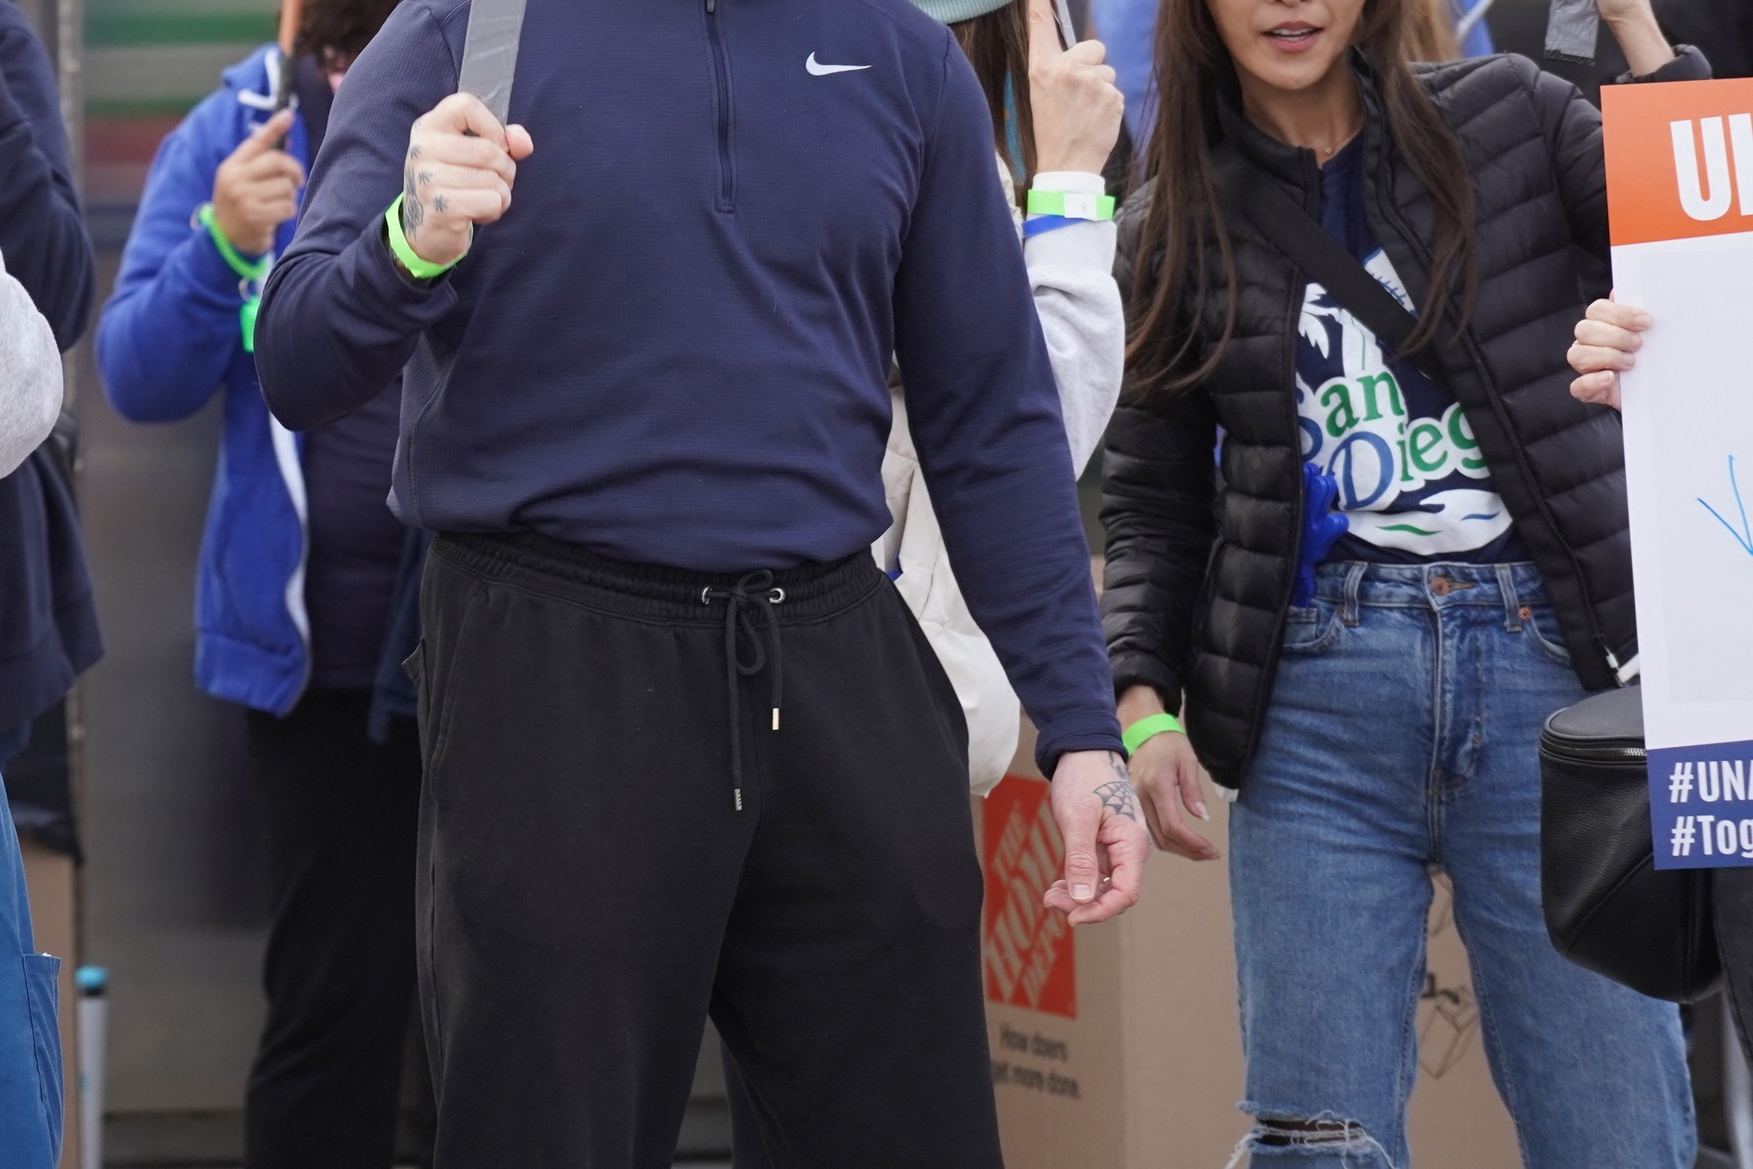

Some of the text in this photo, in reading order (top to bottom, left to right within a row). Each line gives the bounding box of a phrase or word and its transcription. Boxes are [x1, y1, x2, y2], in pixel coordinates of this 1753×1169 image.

[1327, 405, 1488, 510] Dieg
[1669, 759, 1753, 803] #UN
[1022, 914, 1069, 1009] DEP
